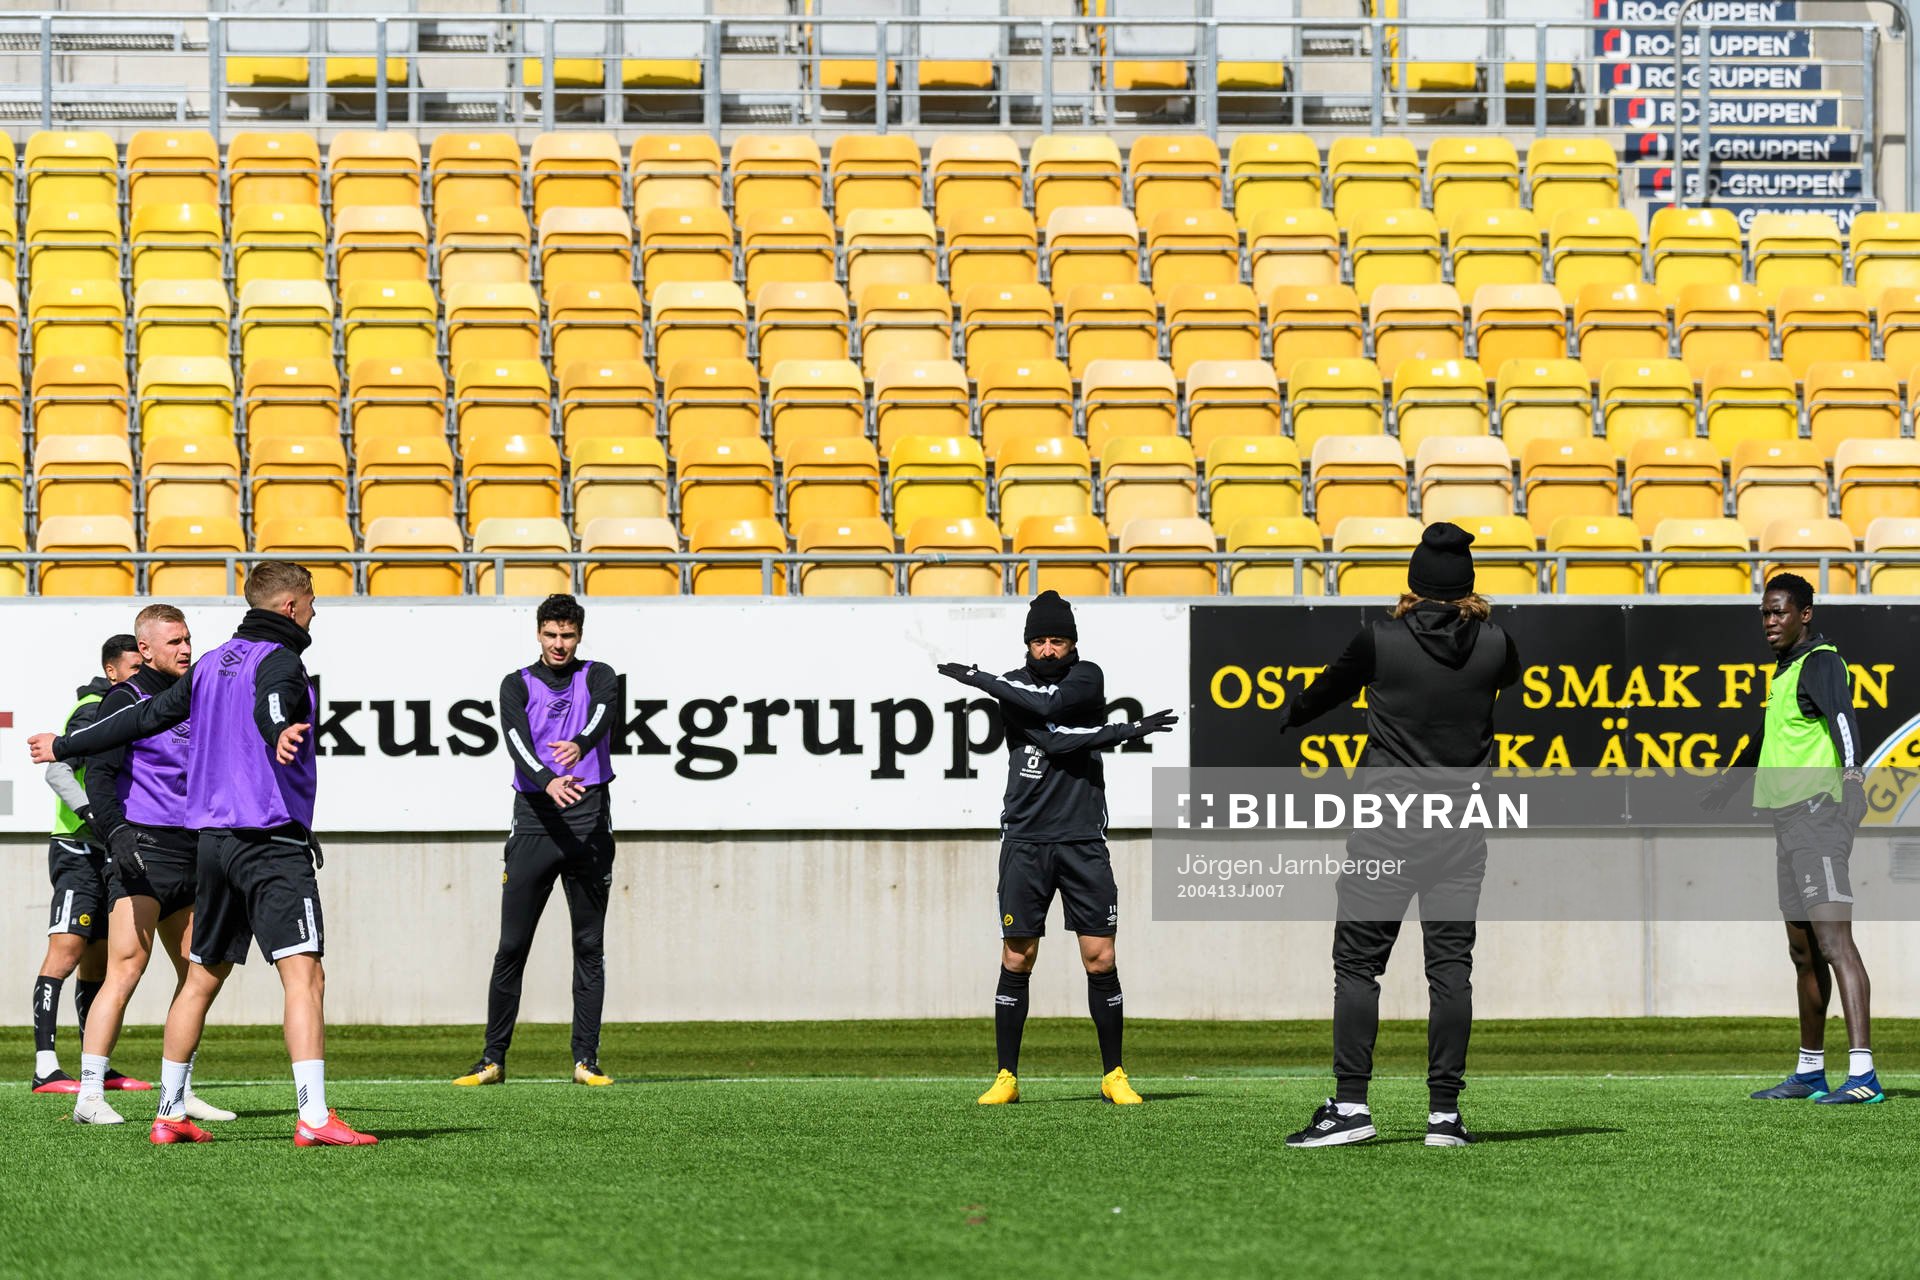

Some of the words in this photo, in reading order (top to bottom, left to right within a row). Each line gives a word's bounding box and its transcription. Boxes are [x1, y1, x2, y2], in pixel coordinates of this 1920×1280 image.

[1522, 664, 1701, 709] SMAK
[1718, 663, 1895, 709] FN
[1590, 717, 1750, 777] ÄNG
